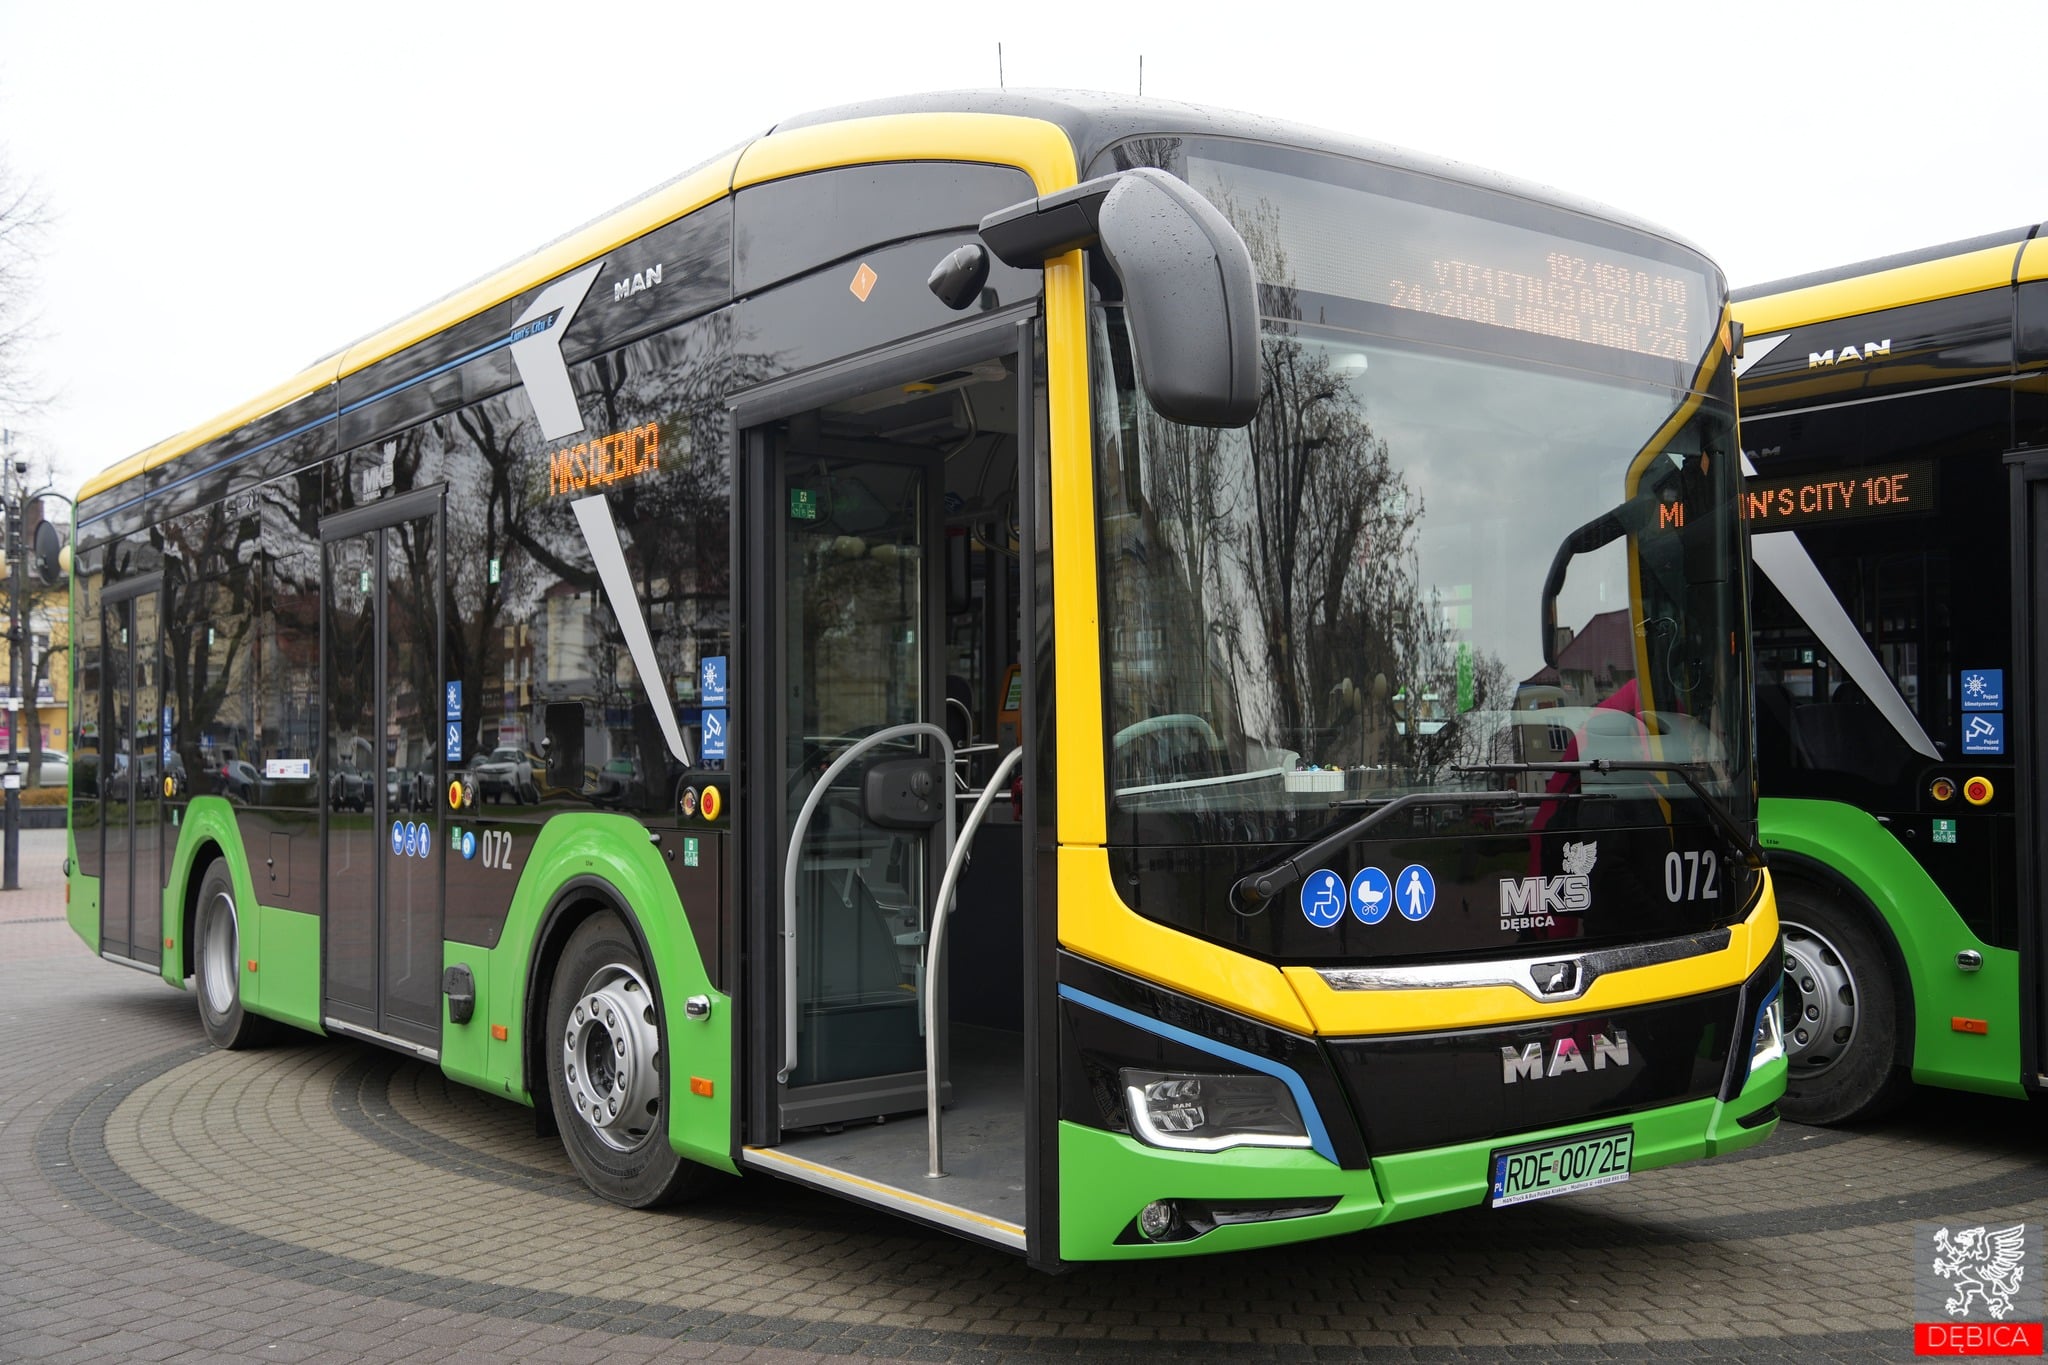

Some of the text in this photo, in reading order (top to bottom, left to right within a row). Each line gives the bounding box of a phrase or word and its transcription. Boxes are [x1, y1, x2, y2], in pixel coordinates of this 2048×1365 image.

[614, 263, 662, 303] MAN
[532, 320, 546, 334] City
[547, 315, 553, 327] E
[1808, 339, 1891, 369] MAN
[550, 443, 588, 496] MKS
[1800, 480, 1855, 513] CITY
[1861, 473, 1910, 504] 10E
[482, 829, 512, 870] 072
[1500, 850, 1718, 917] MKS 072
[1500, 916, 1556, 932] DĘBICA
[1503, 1030, 1630, 1084] MAN
[1506, 1137, 1628, 1193] RDE 0072E
[1494, 1182, 1503, 1193] PL
